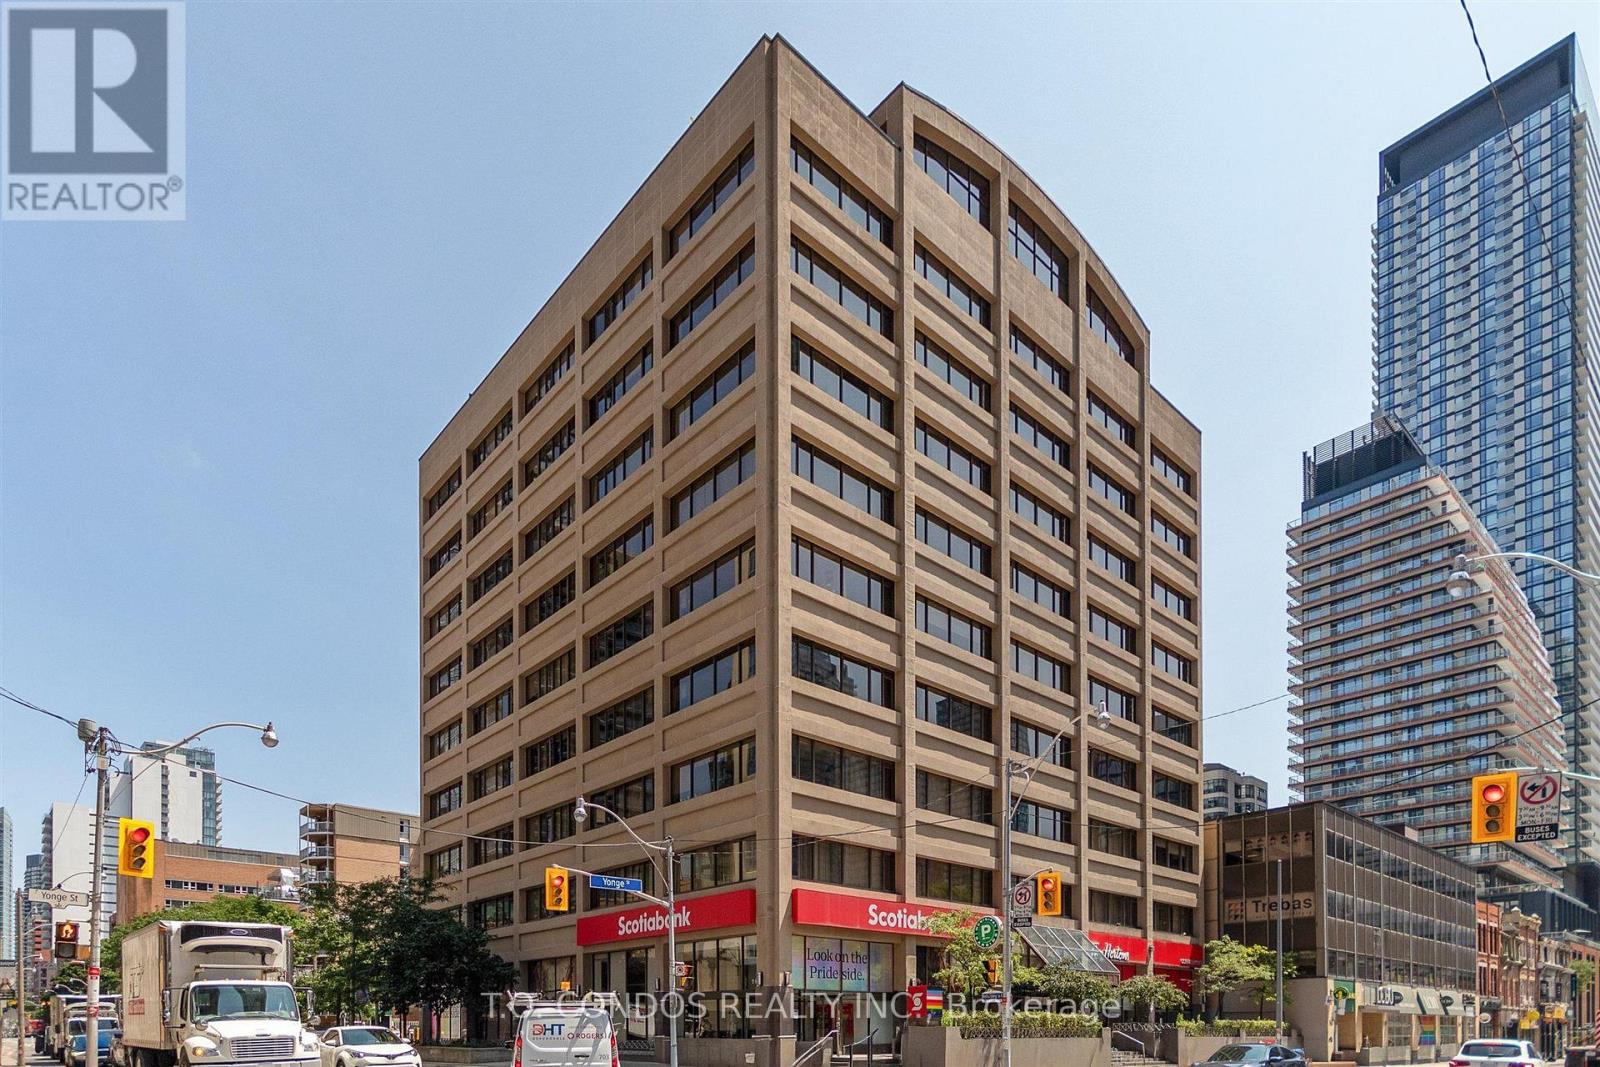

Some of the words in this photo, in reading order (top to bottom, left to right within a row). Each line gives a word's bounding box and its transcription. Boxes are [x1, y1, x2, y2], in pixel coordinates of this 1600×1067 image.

[1524, 825, 1550, 834] BUSES
[1517, 832, 1556, 841] EXCEPTED
[602, 878, 625, 889] Yonge
[40, 891, 67, 902] Yonge
[70, 894, 78, 903] St
[1252, 898, 1313, 913] Trebas
[807, 948, 833, 961] Look
[834, 951, 849, 963] on
[850, 951, 868, 964] the
[809, 966, 839, 979] Pride
[841, 967, 865, 981] side.
[532, 1023, 566, 1036] DHT
[576, 1032, 604, 1040] ROGERS
